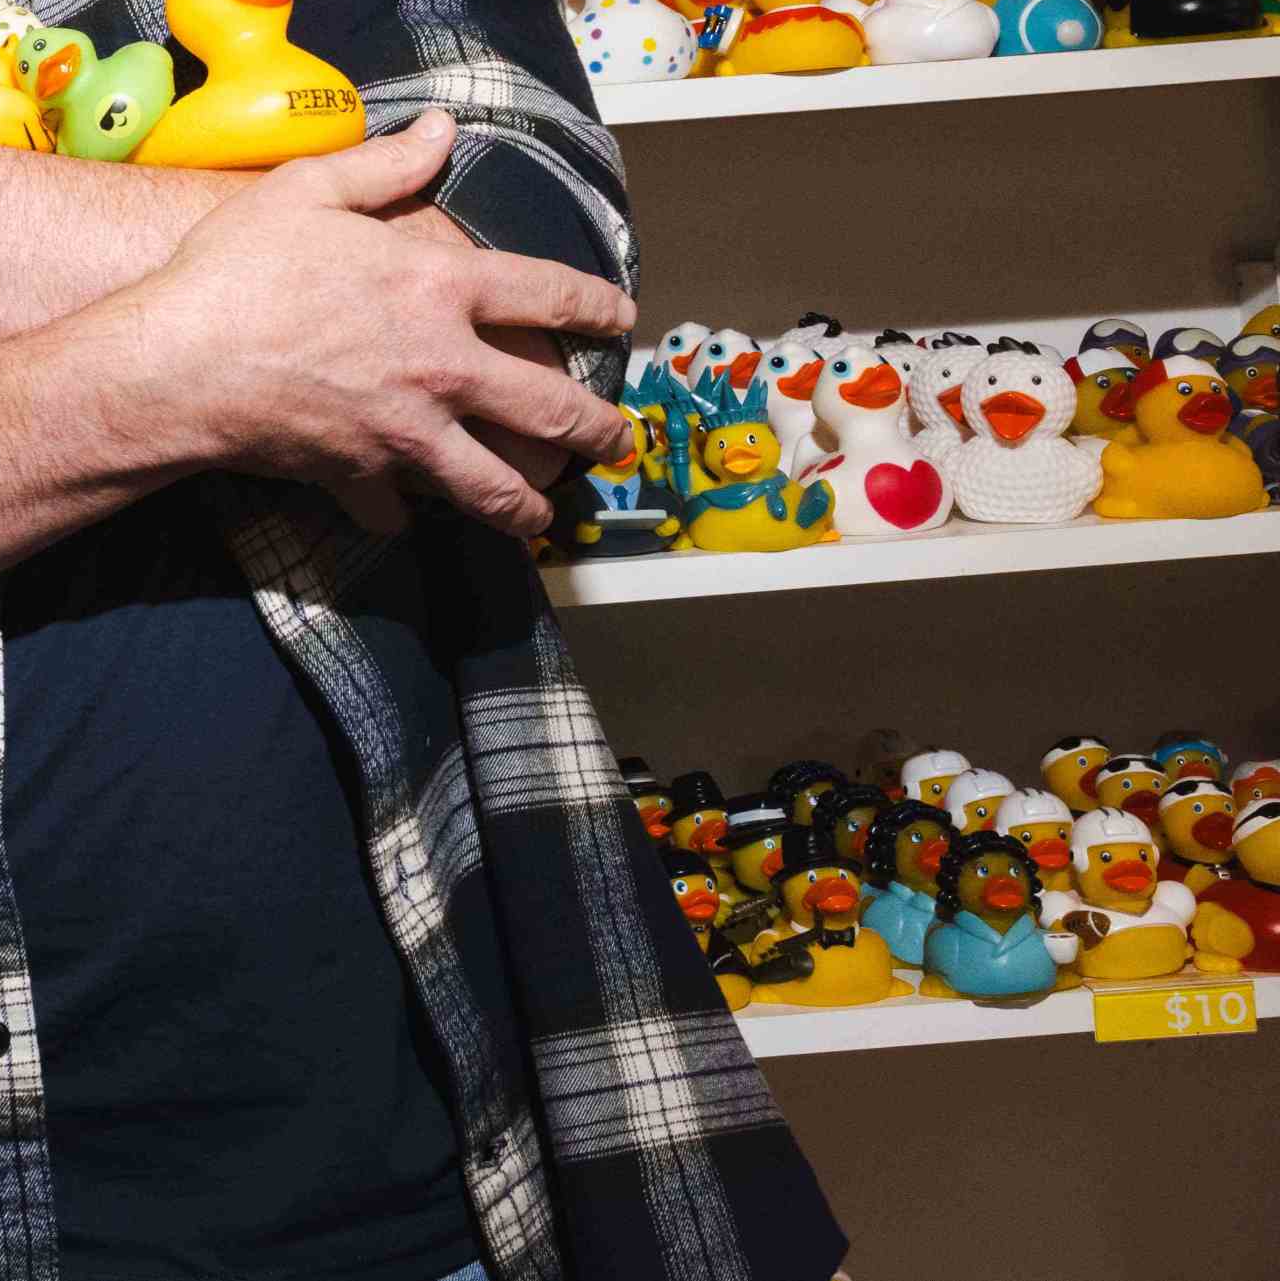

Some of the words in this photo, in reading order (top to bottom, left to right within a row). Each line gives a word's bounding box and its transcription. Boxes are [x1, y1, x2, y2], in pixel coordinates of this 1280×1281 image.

[285, 89, 338, 110] PIER
[337, 89, 357, 113] 39
[1165, 991, 1248, 1034] $10
